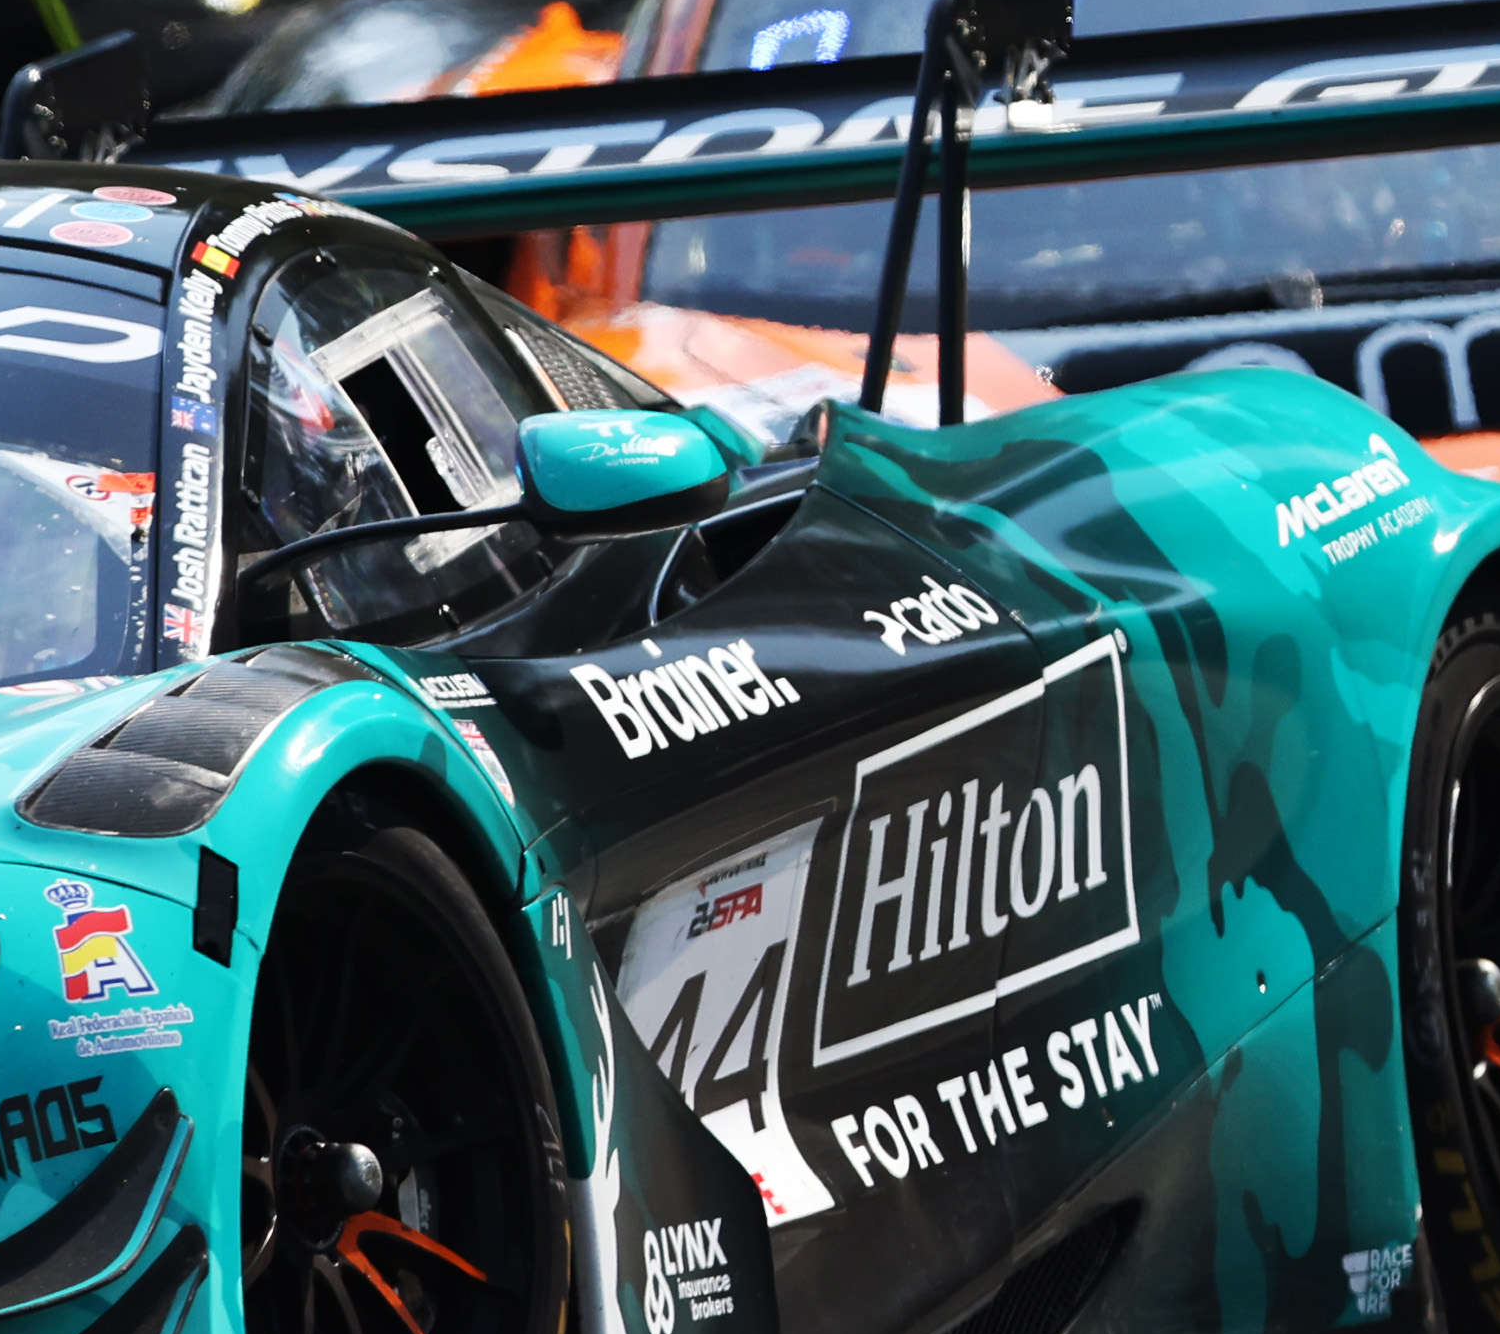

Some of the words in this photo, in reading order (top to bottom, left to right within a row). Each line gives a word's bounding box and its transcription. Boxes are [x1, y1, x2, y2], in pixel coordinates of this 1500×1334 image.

[178, 268, 223, 320] Kelly
[177, 319, 218, 404] Jayden
[174, 442, 211, 547] Rattican
[1275, 450, 1410, 547] McLaren
[1321, 522, 1379, 565] TROPHY
[1376, 496, 1434, 537] ACADEMY
[171, 548, 206, 611] Josh
[847, 763, 1107, 987] Hilton
[77, 1037, 94, 1057] de
[831, 1094, 945, 1188] FOR
[937, 1046, 1048, 1153] THE
[660, 1217, 728, 1276] LYNX
[1370, 1244, 1413, 1269] RACE
[677, 1273, 731, 1299] insurance
[690, 1295, 734, 1321] brokers
